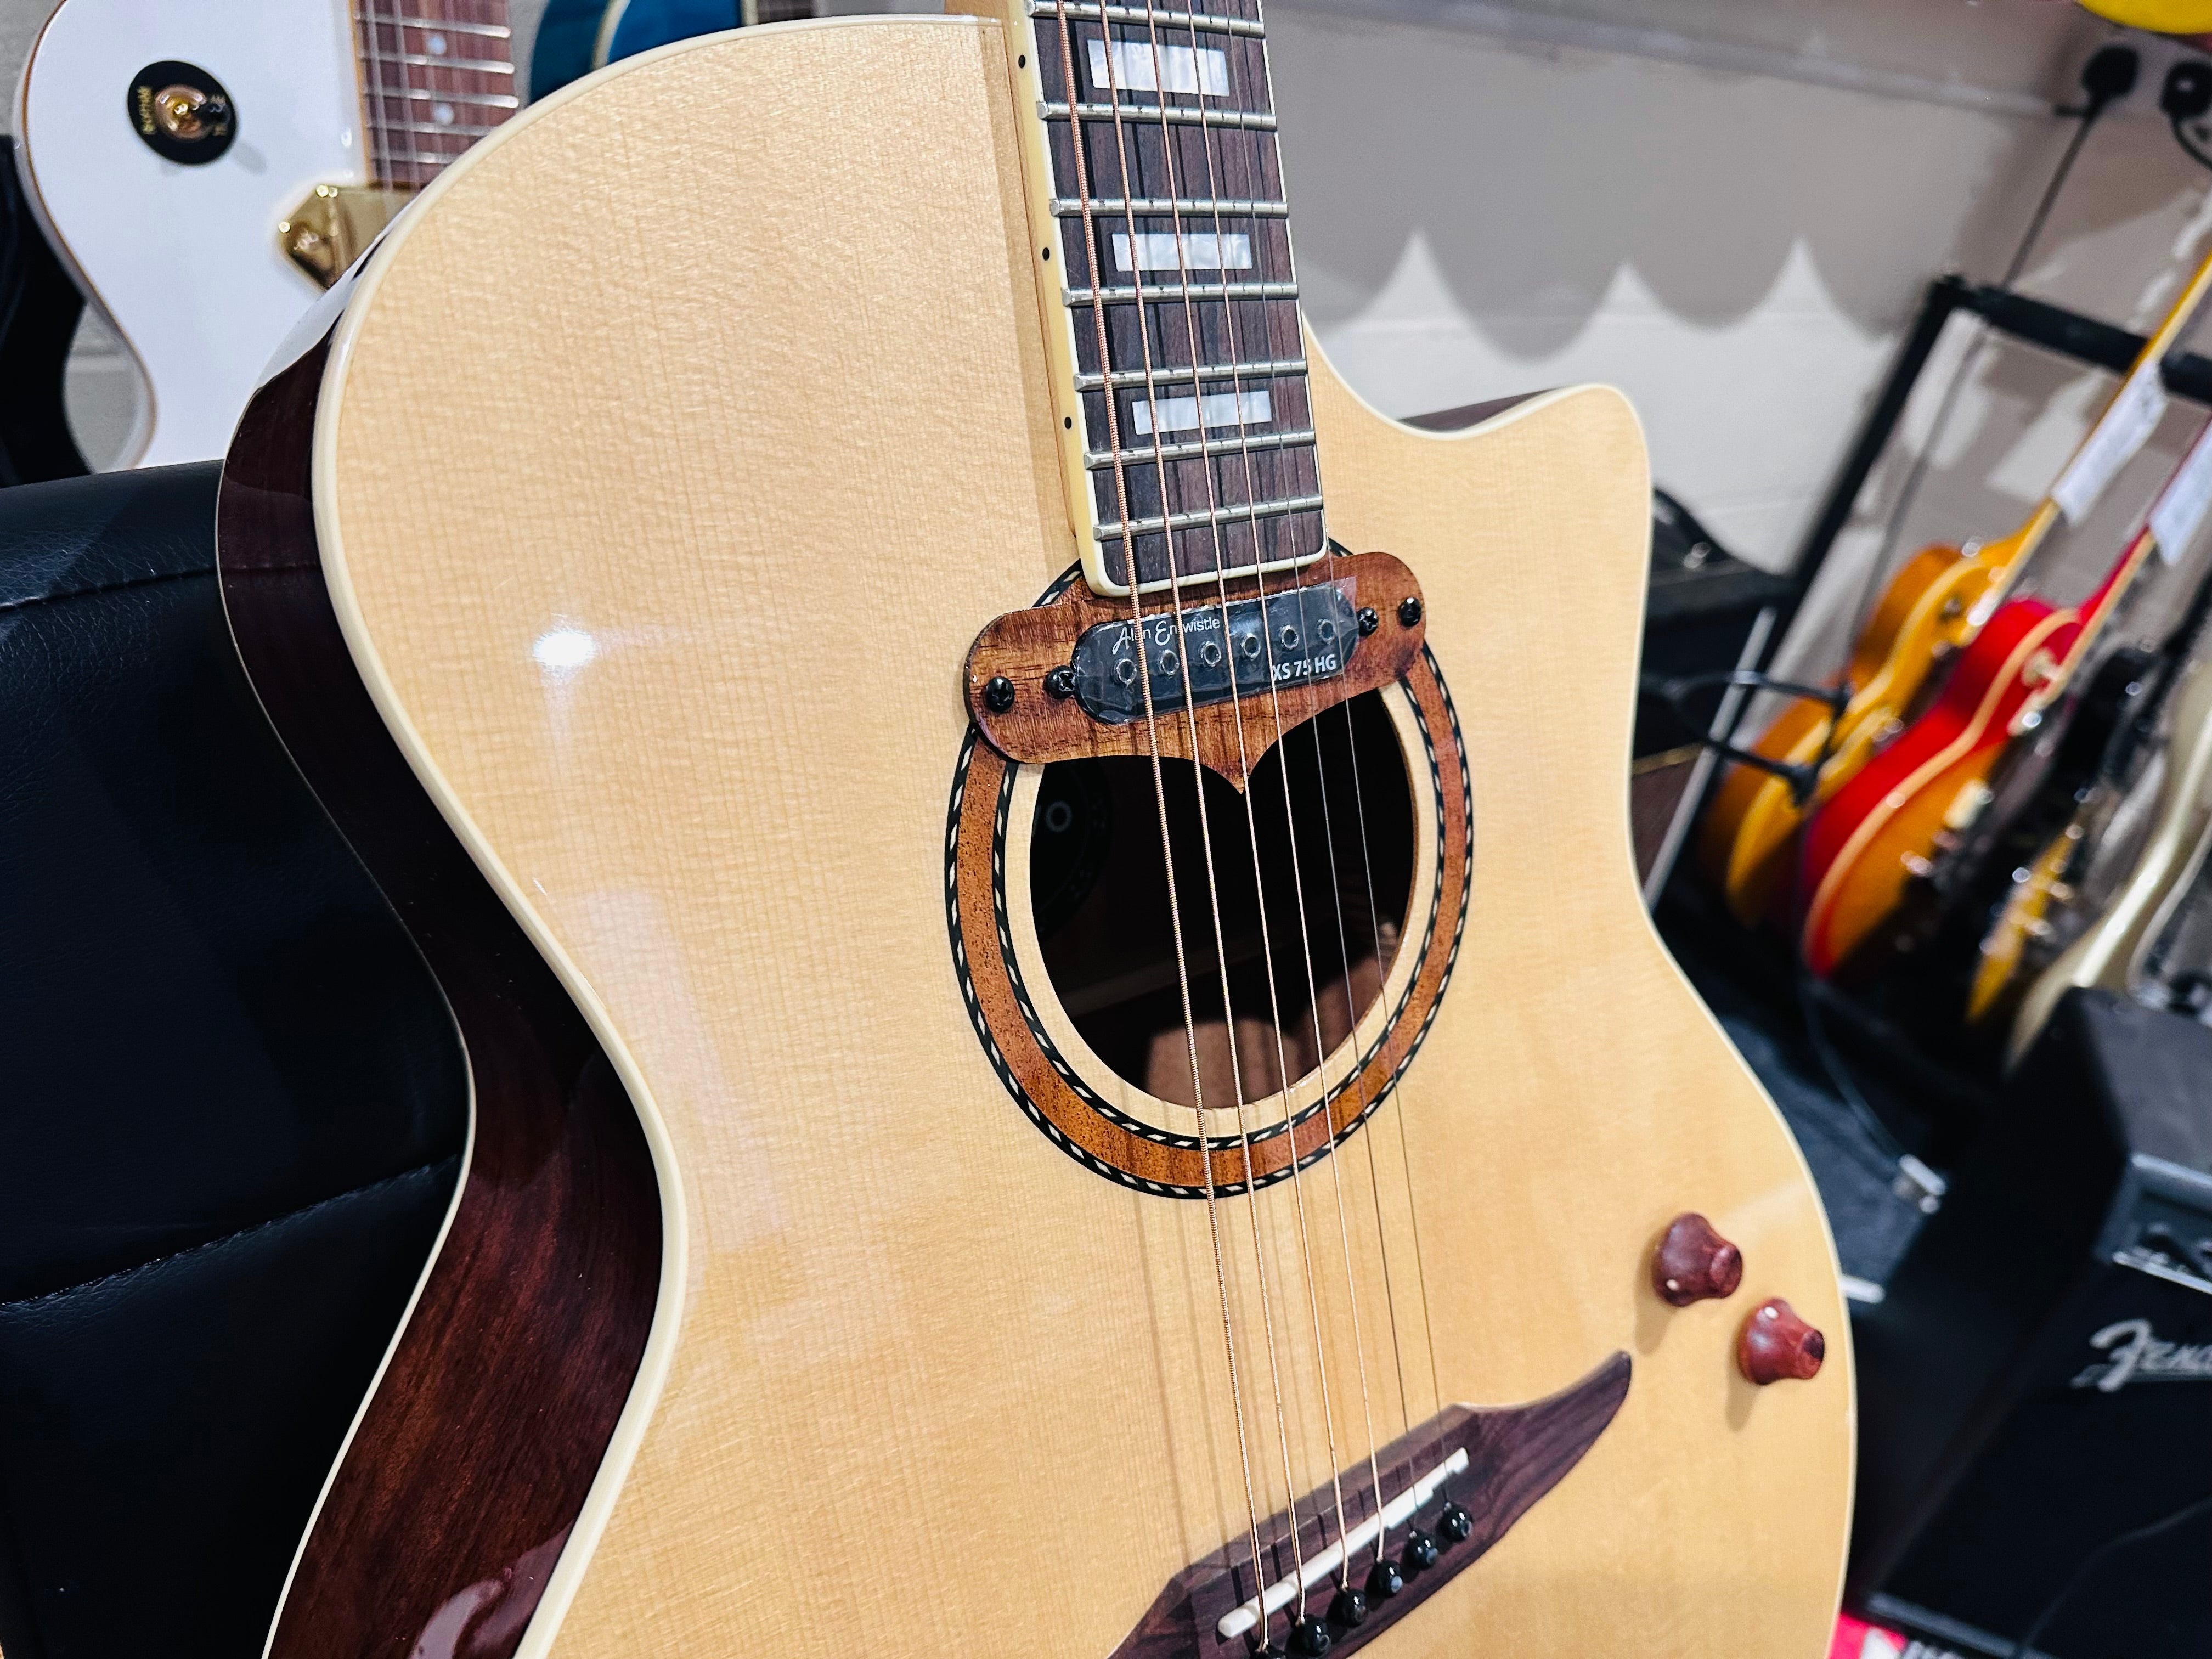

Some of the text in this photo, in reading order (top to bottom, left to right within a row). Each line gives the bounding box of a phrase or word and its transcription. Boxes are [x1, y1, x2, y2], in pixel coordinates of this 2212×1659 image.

[1155, 616, 1220, 646] Enwistle
[1272, 654, 1336, 680] XS 75 HG
